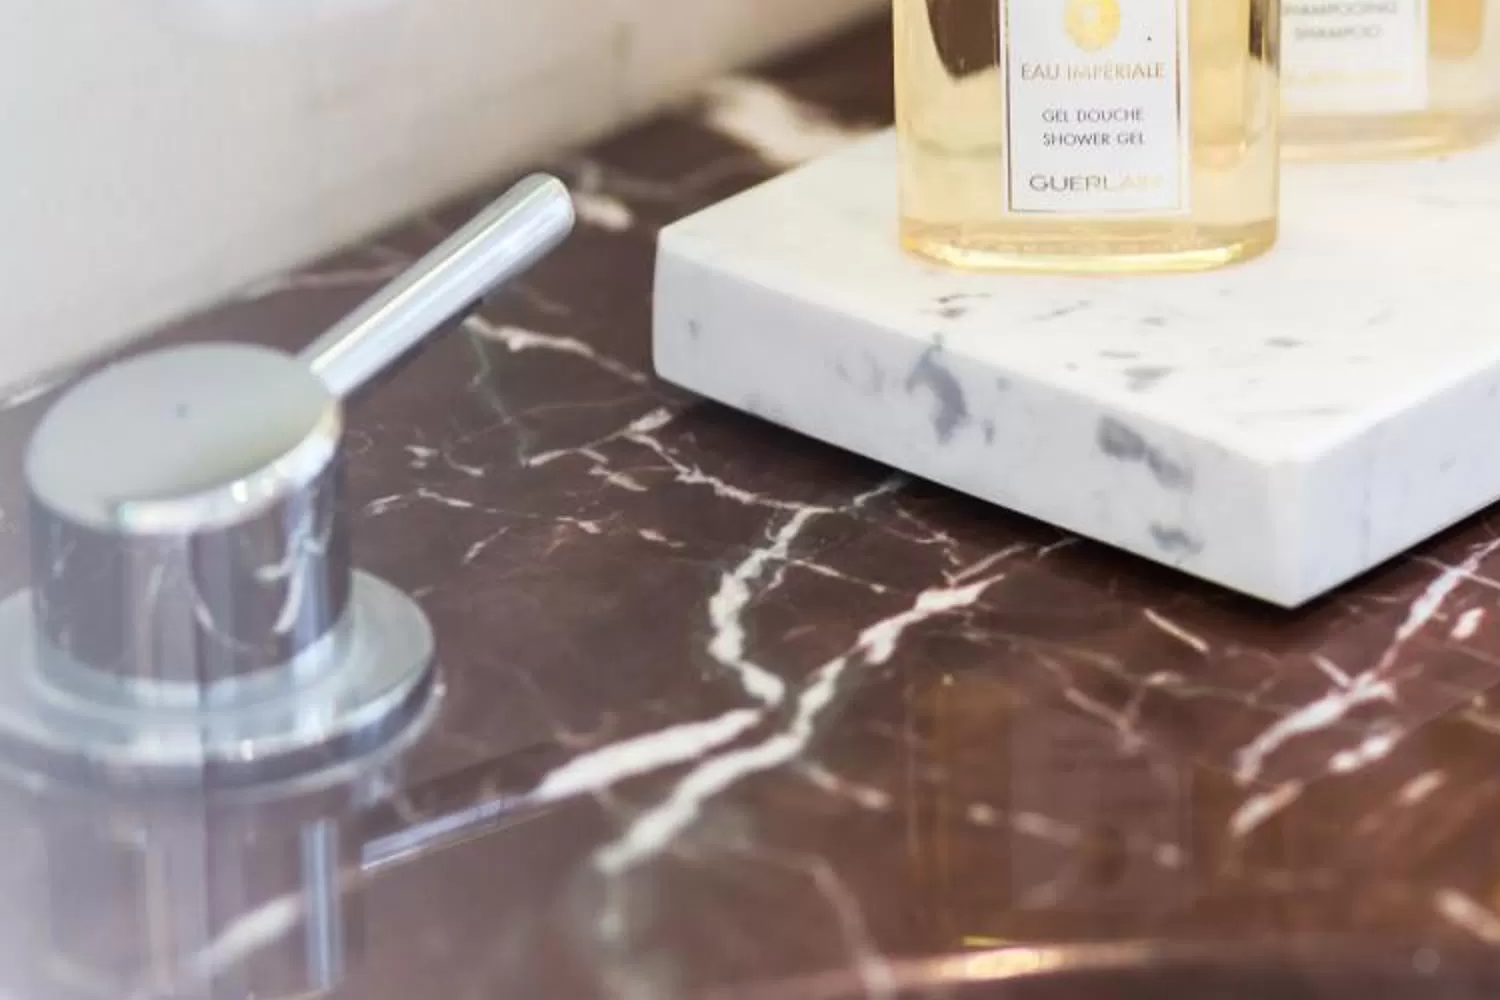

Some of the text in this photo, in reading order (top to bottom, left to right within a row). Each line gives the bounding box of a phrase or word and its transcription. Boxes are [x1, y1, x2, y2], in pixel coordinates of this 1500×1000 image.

[1021, 63, 1060, 81] EAU
[1041, 107, 1145, 123] GEL DOUCHE
[1043, 131, 1145, 147] SHOWER GEL
[1029, 174, 1163, 192] GUERLAI
